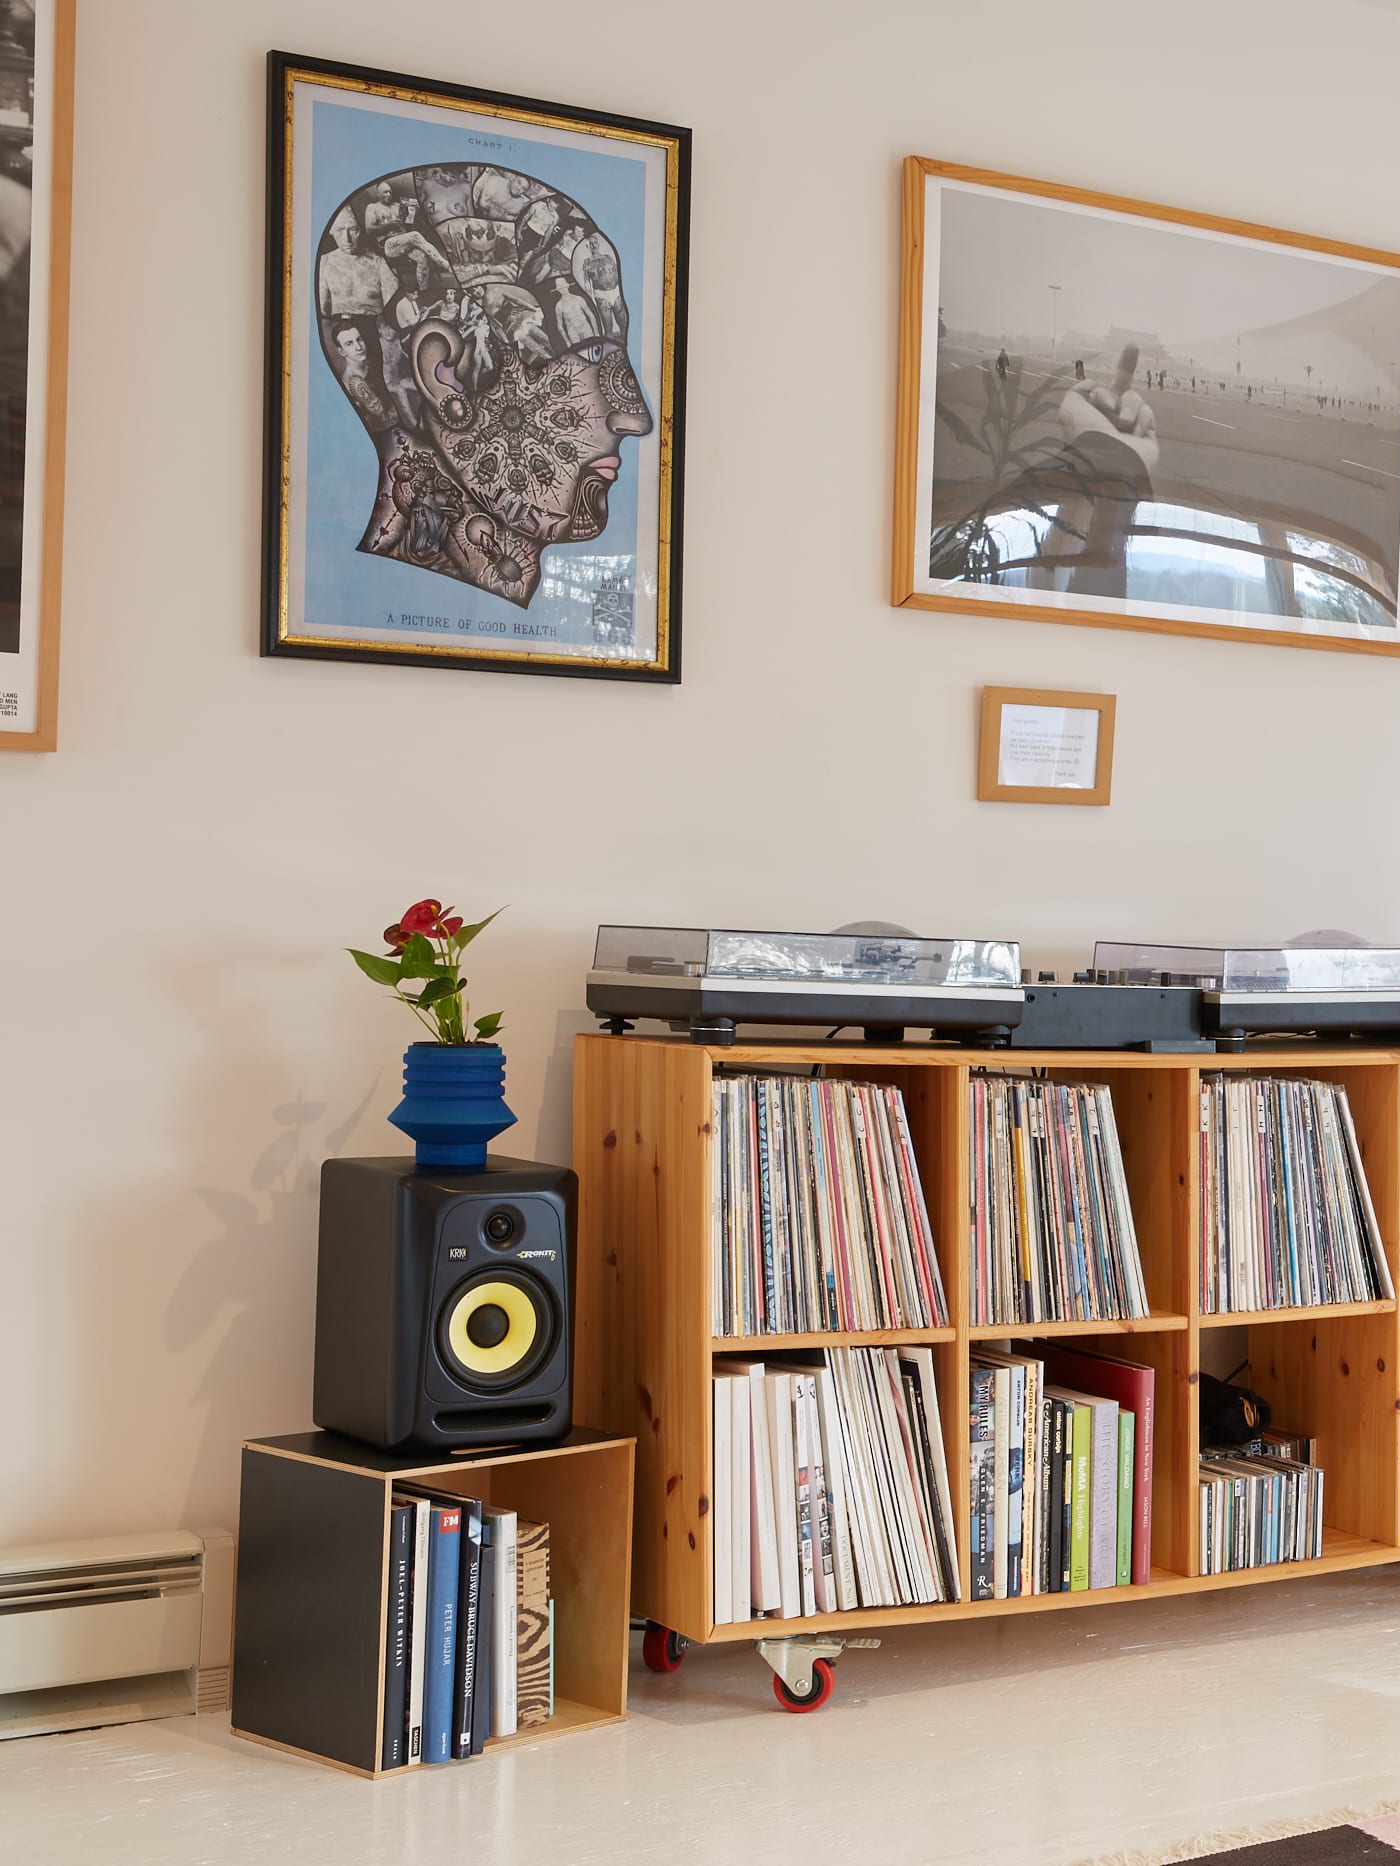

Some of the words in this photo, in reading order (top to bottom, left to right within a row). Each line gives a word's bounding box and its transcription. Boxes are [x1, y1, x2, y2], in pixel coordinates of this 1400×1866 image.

[387, 613, 394, 624] A
[401, 614, 450, 628] PICTURE
[458, 619, 472, 630] OF
[478, 620, 506, 633] GOOD
[513, 623, 557, 637] HEALTH
[449, 1247, 464, 1259] KRK
[978, 1385, 989, 1402] MY
[1145, 1397, 1152, 1406] An
[978, 1405, 989, 1439] RULES
[1043, 1410, 1052, 1457] American
[1042, 1456, 1051, 1491] Album
[1077, 1456, 1087, 1491] MoMA
[980, 1498, 987, 1507] E.
[1075, 1494, 1086, 1539] Highlights
[443, 1514, 459, 1527] FM
[979, 1513, 987, 1564] FRIEDMAN
[840, 1535, 852, 1584] DOCUMENT
[397, 1560, 406, 1624] JOEL-PETER
[468, 1562, 478, 1603] SUBWAY
[443, 1603, 453, 1632] PETER
[466, 1607, 476, 1642] BRUCE
[396, 1629, 404, 1667] WITKIN
[443, 1637, 452, 1666] HUJAR
[464, 1643, 474, 1697] DAVIDSON
